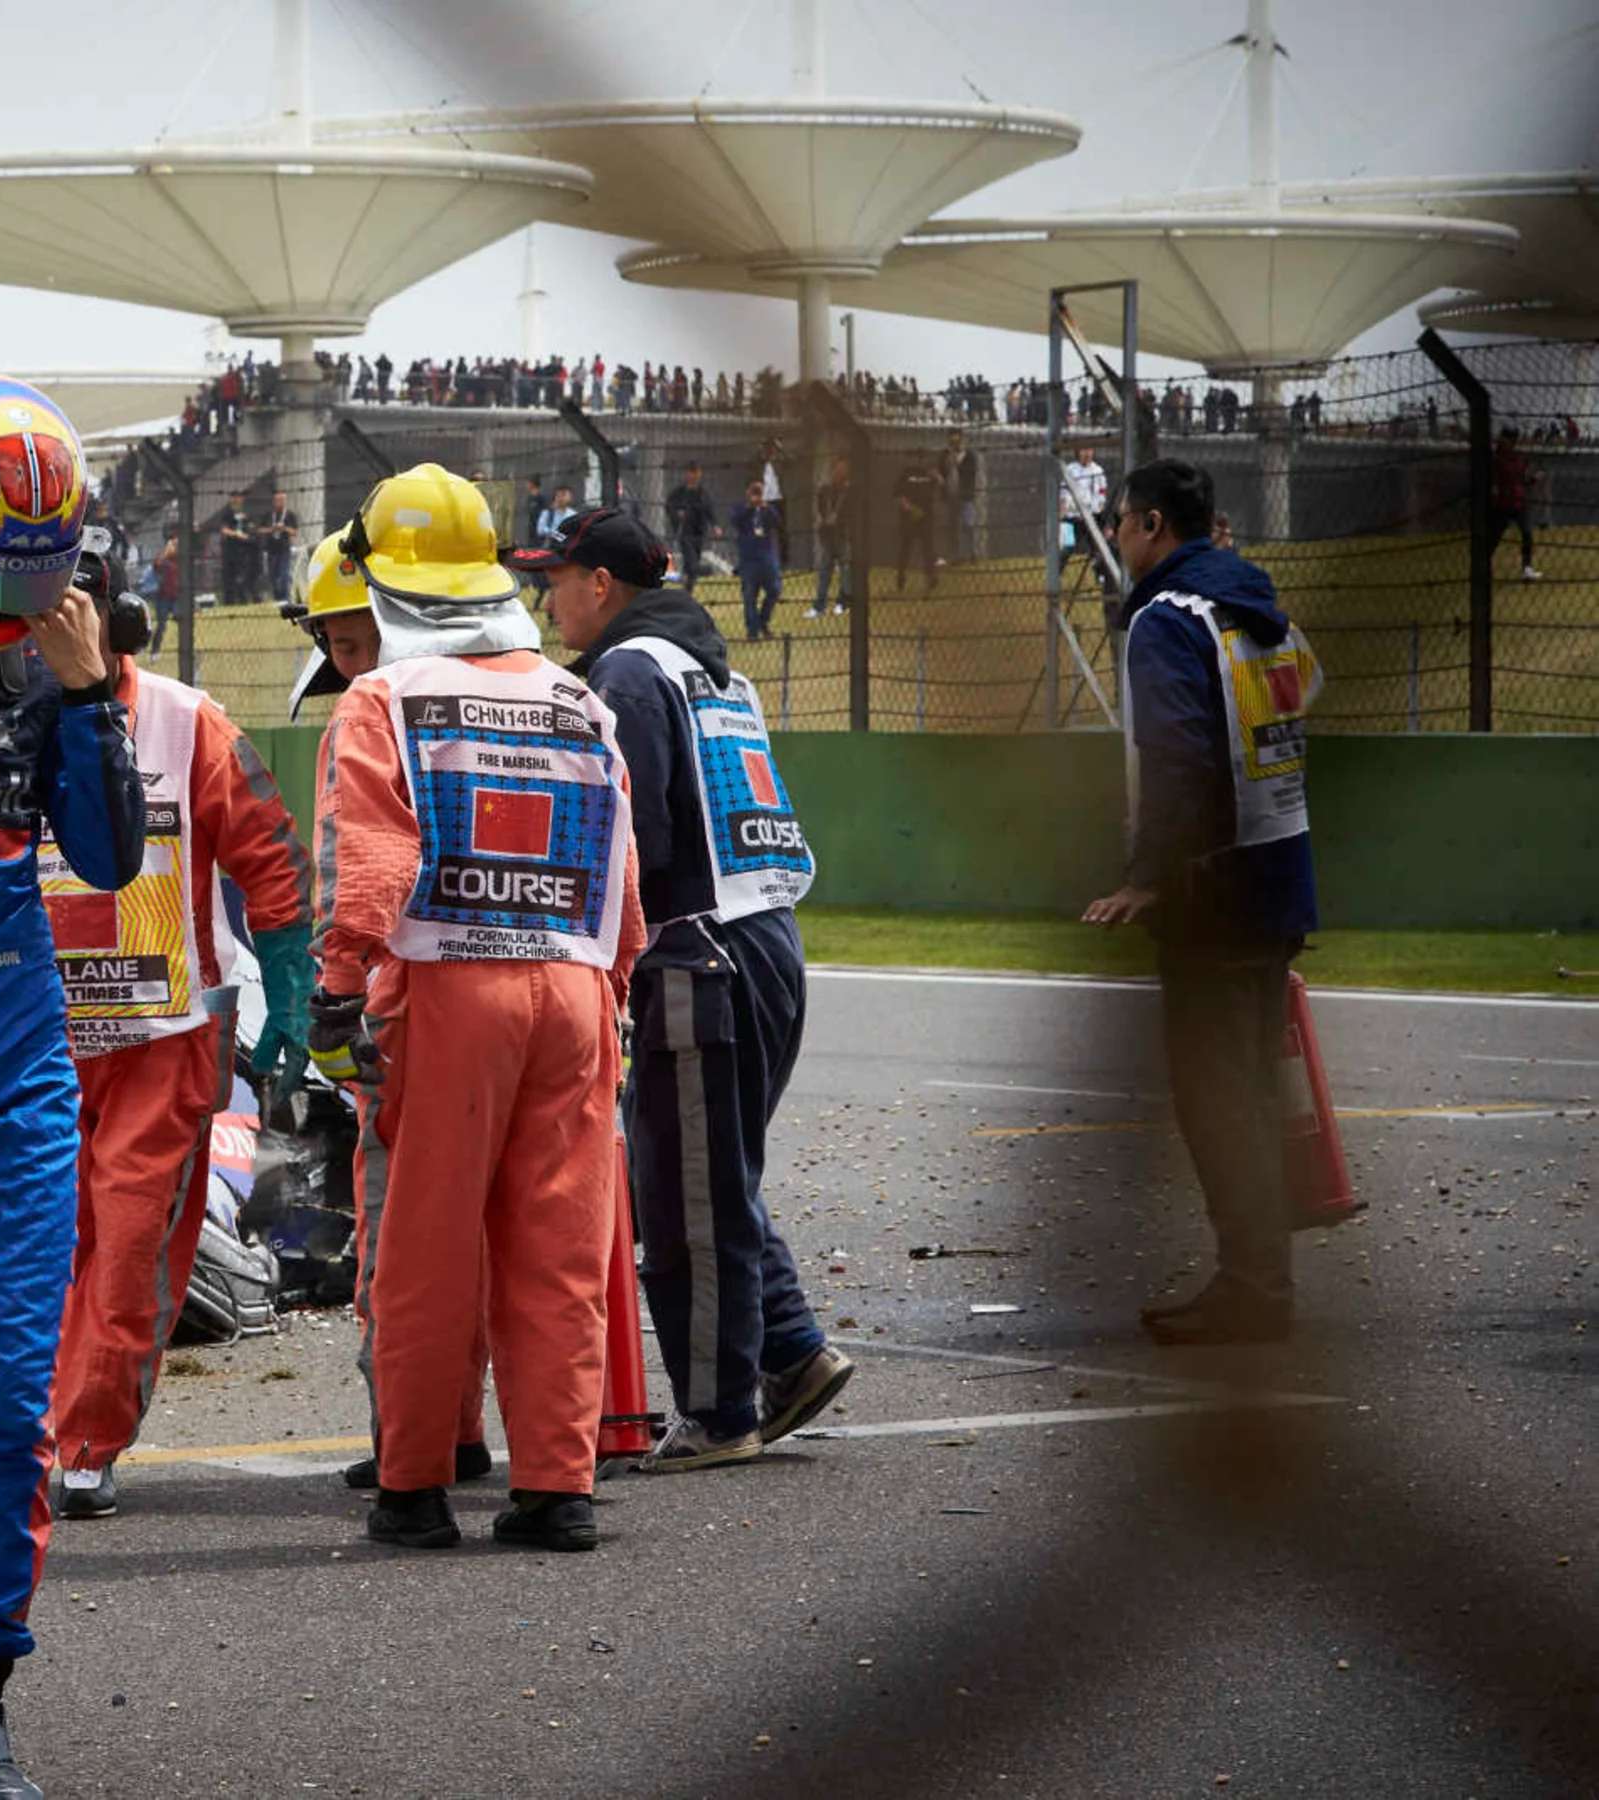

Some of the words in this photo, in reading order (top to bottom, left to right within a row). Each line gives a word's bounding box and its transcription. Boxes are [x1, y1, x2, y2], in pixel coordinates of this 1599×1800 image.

[463, 704, 552, 728] CHN1486
[478, 753, 499, 767] FIRE
[502, 755, 552, 770] MARSHAL
[440, 867, 575, 909] COURSE
[467, 929, 536, 943] FORMULA
[539, 933, 548, 944] 1
[438, 938, 513, 957] HEINEKEN
[516, 946, 572, 960] CHINESE
[65, 960, 139, 980] LANE
[67, 985, 133, 1001] TIMES
